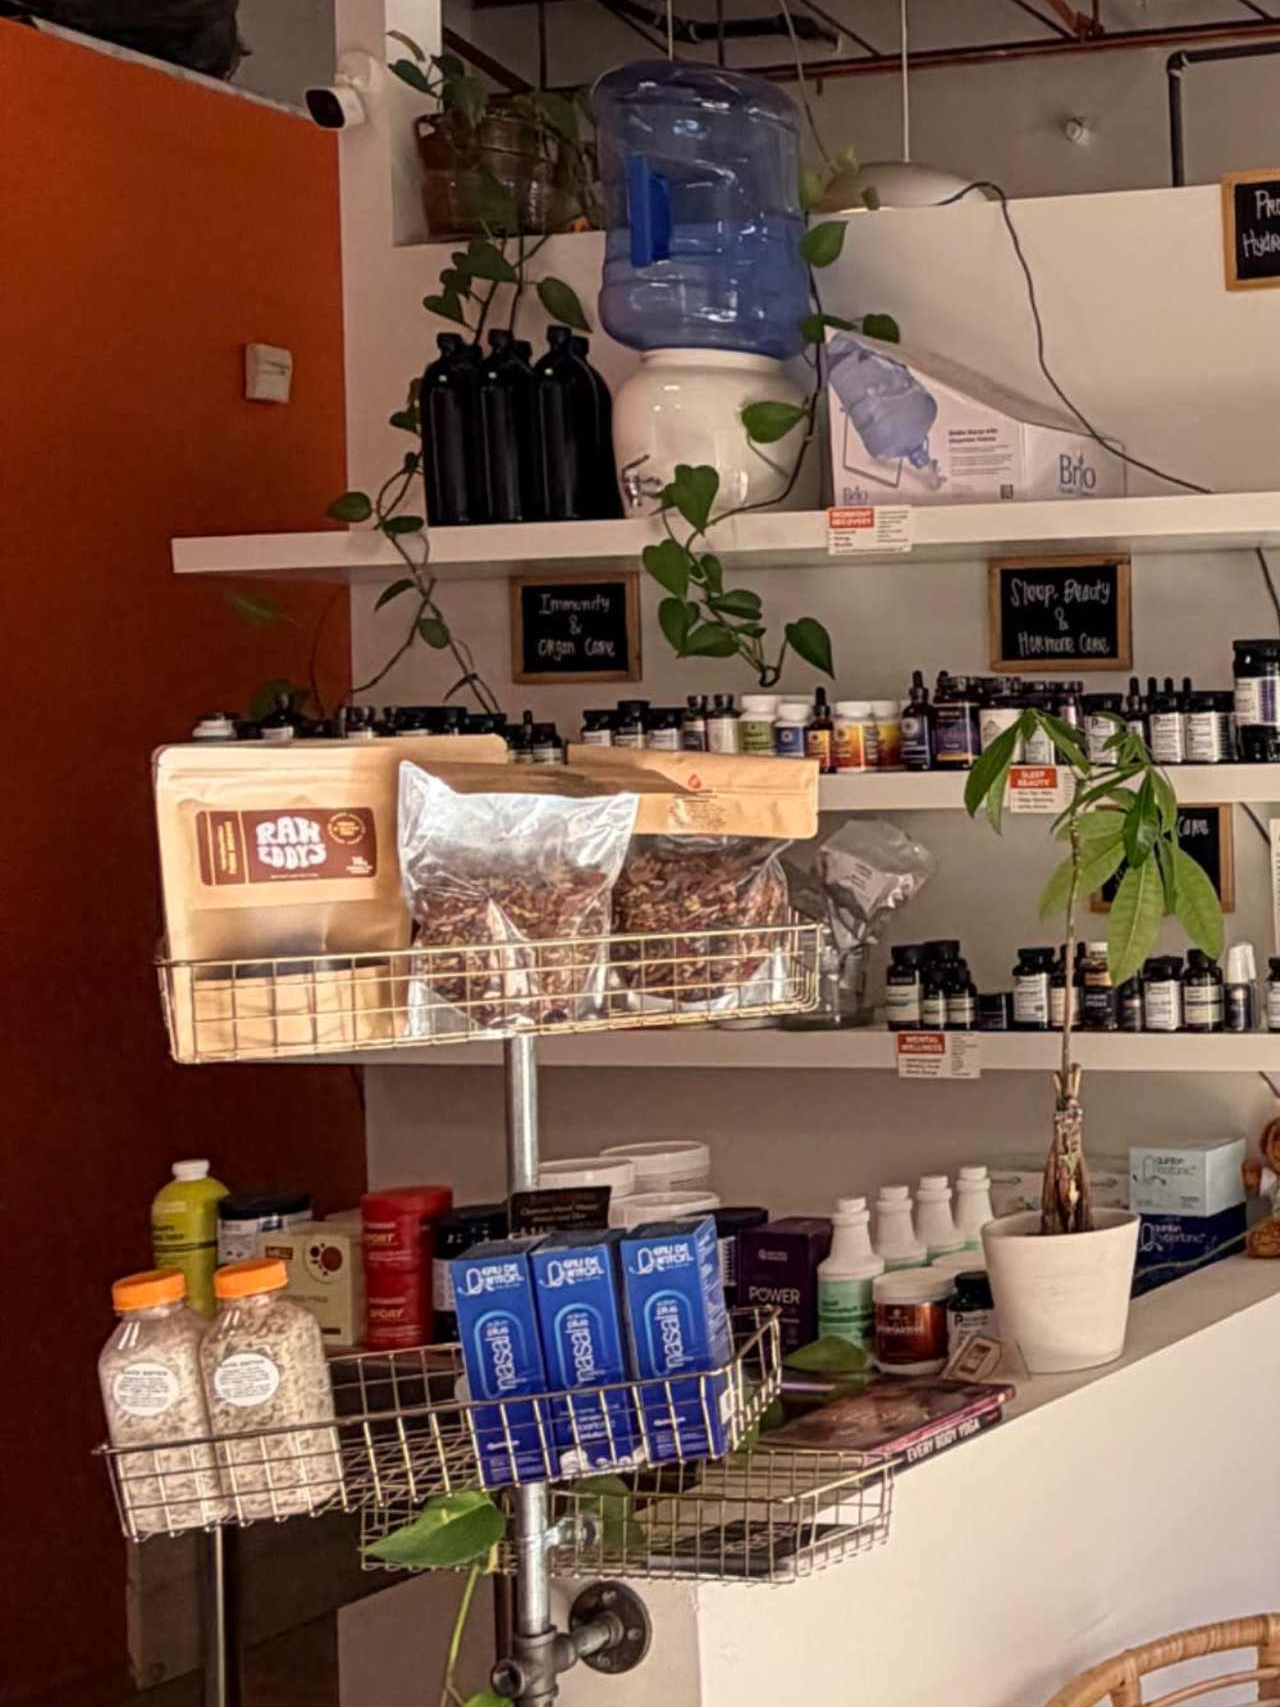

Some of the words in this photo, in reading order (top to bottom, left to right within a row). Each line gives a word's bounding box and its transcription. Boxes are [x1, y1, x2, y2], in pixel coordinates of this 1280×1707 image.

[538, 592, 610, 615] Immunity
[255, 816, 320, 845] RAW
[749, 1285, 801, 1305] POWER
[907, 1436, 934, 1463] EVERY
[934, 1425, 959, 1451] BODY
[958, 1418, 981, 1439] YOGA
